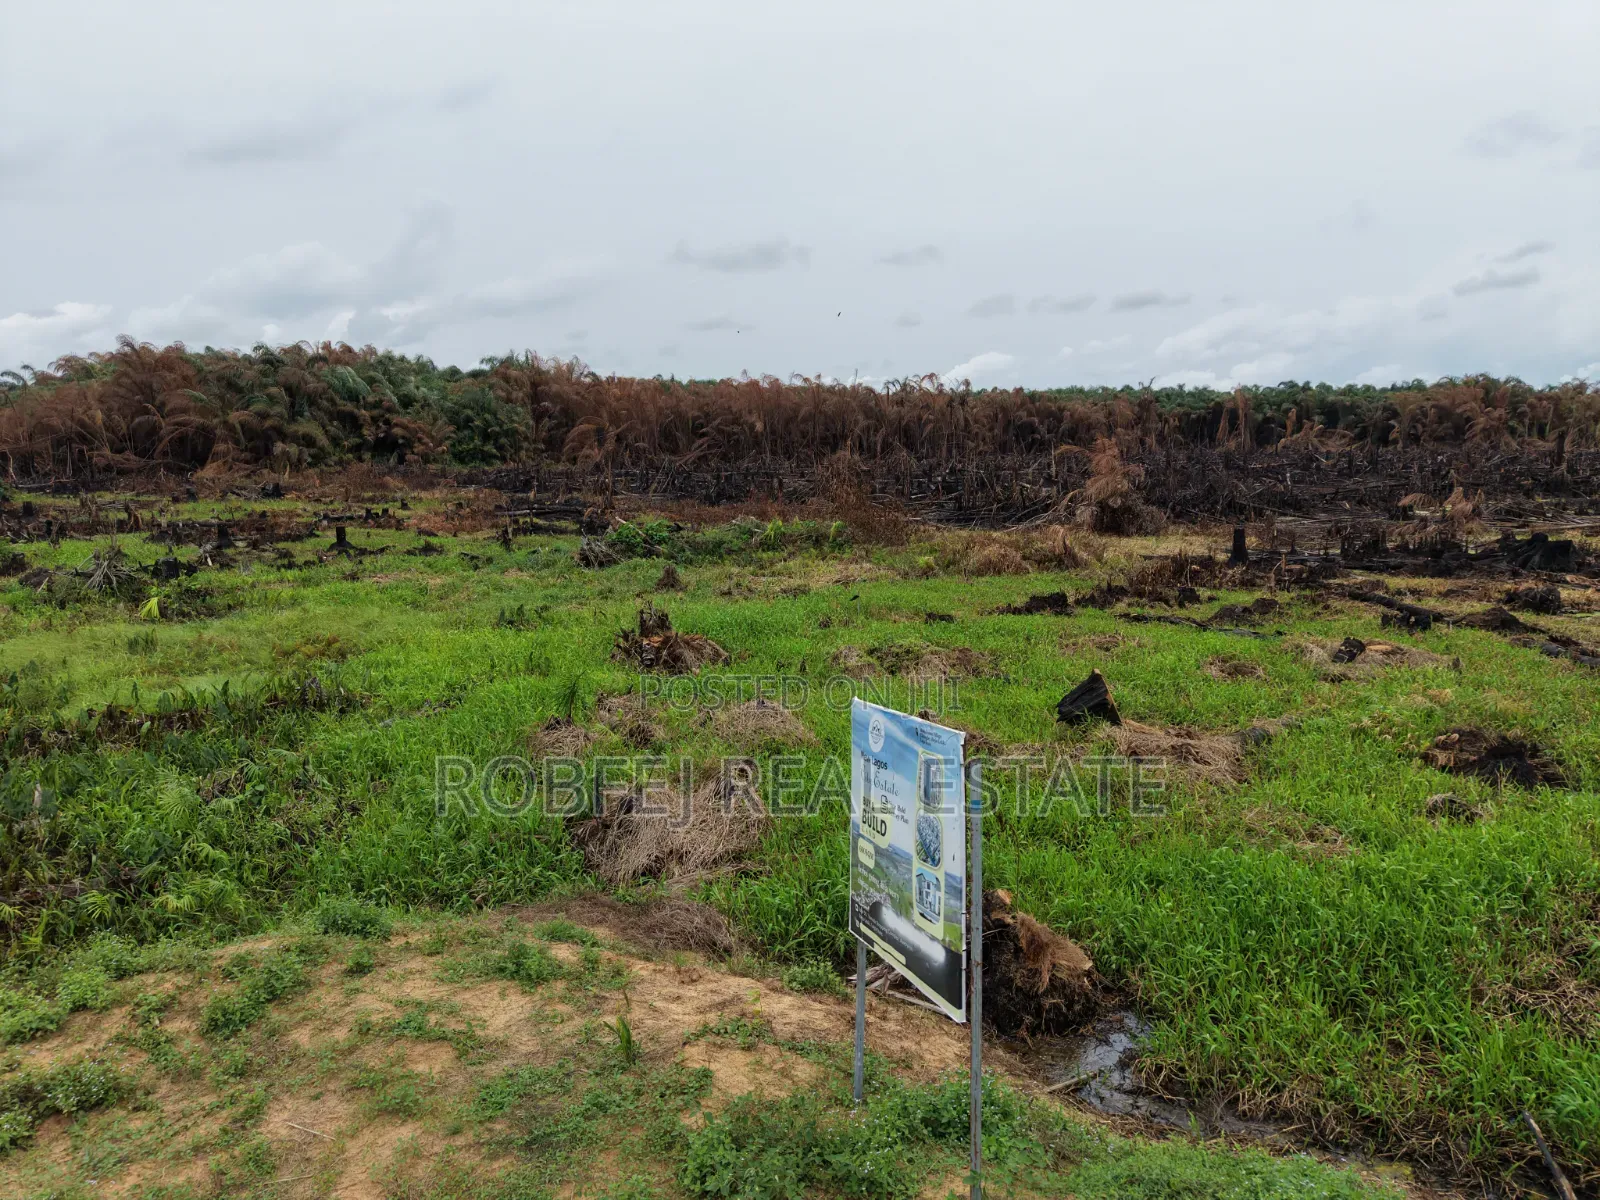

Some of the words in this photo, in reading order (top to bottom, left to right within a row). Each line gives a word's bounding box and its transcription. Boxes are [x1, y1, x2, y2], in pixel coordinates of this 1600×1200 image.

[872, 755, 888, 770] Lagos
[874, 771, 900, 797] Estate
[862, 808, 888, 837] BUILD
